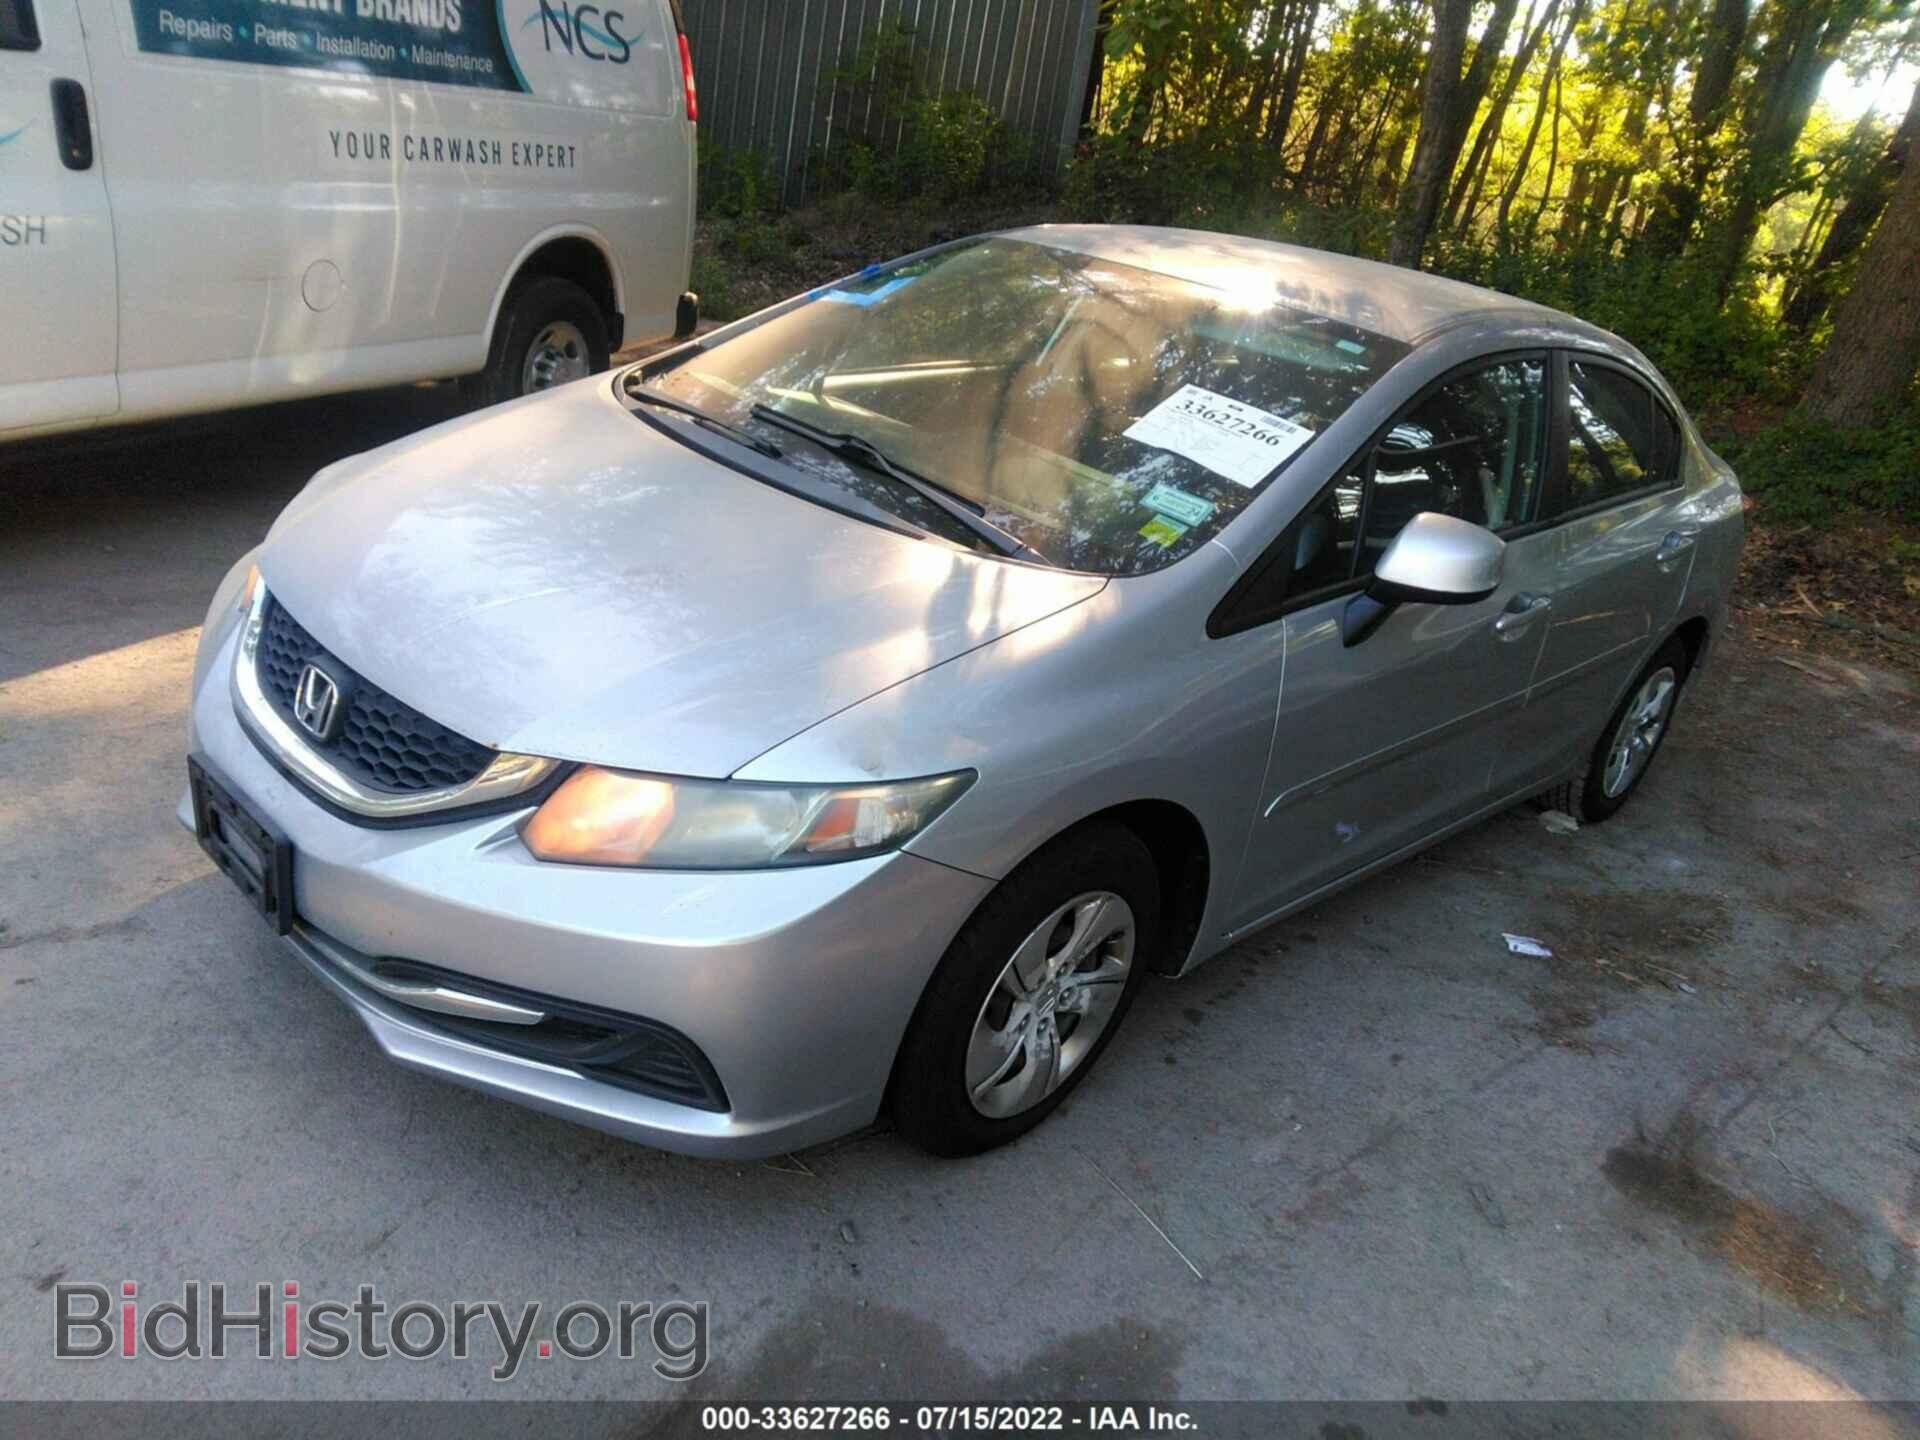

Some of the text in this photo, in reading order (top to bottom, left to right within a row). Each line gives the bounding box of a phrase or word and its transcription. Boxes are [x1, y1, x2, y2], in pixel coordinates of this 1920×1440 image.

[159, 9, 494, 73] Repairs Parts Installation Maintenance
[538, 0, 631, 64] NCS
[328, 130, 576, 168] YOUR CARWASH EXPERT
[1175, 399, 1283, 446] 33627266
